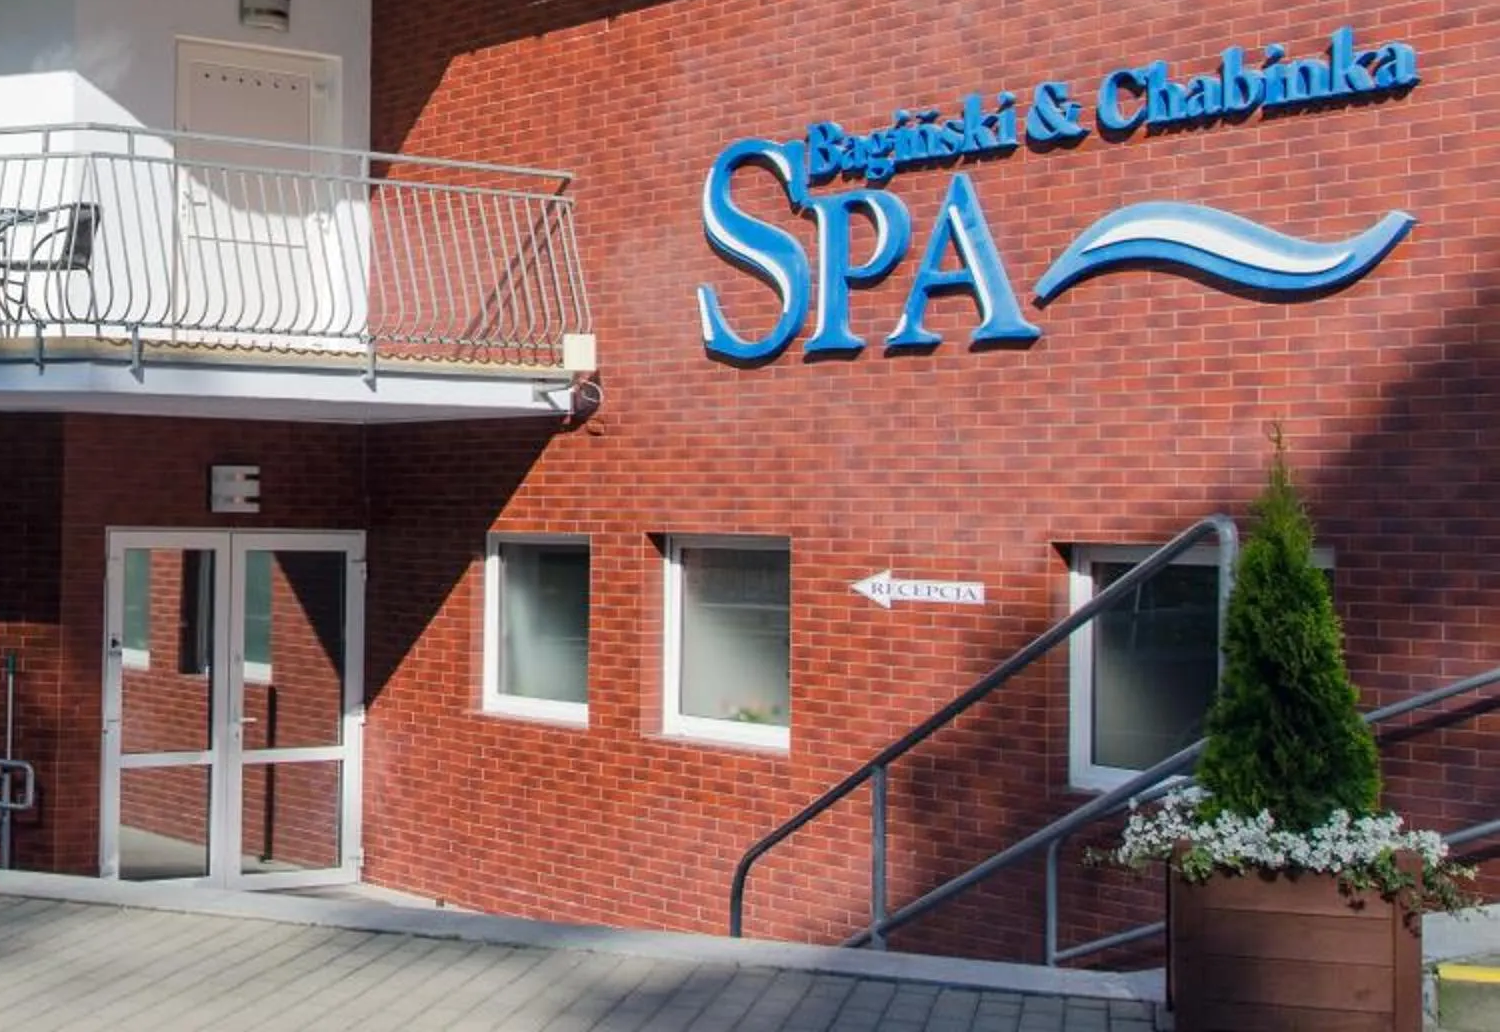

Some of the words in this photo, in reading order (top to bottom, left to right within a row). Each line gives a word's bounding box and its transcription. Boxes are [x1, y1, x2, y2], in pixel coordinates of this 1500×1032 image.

[1026, 82, 1090, 152] &
[1097, 26, 1420, 140] Chabinka
[697, 138, 1041, 362] SPA
[871, 582, 977, 601] RECEPCJA
